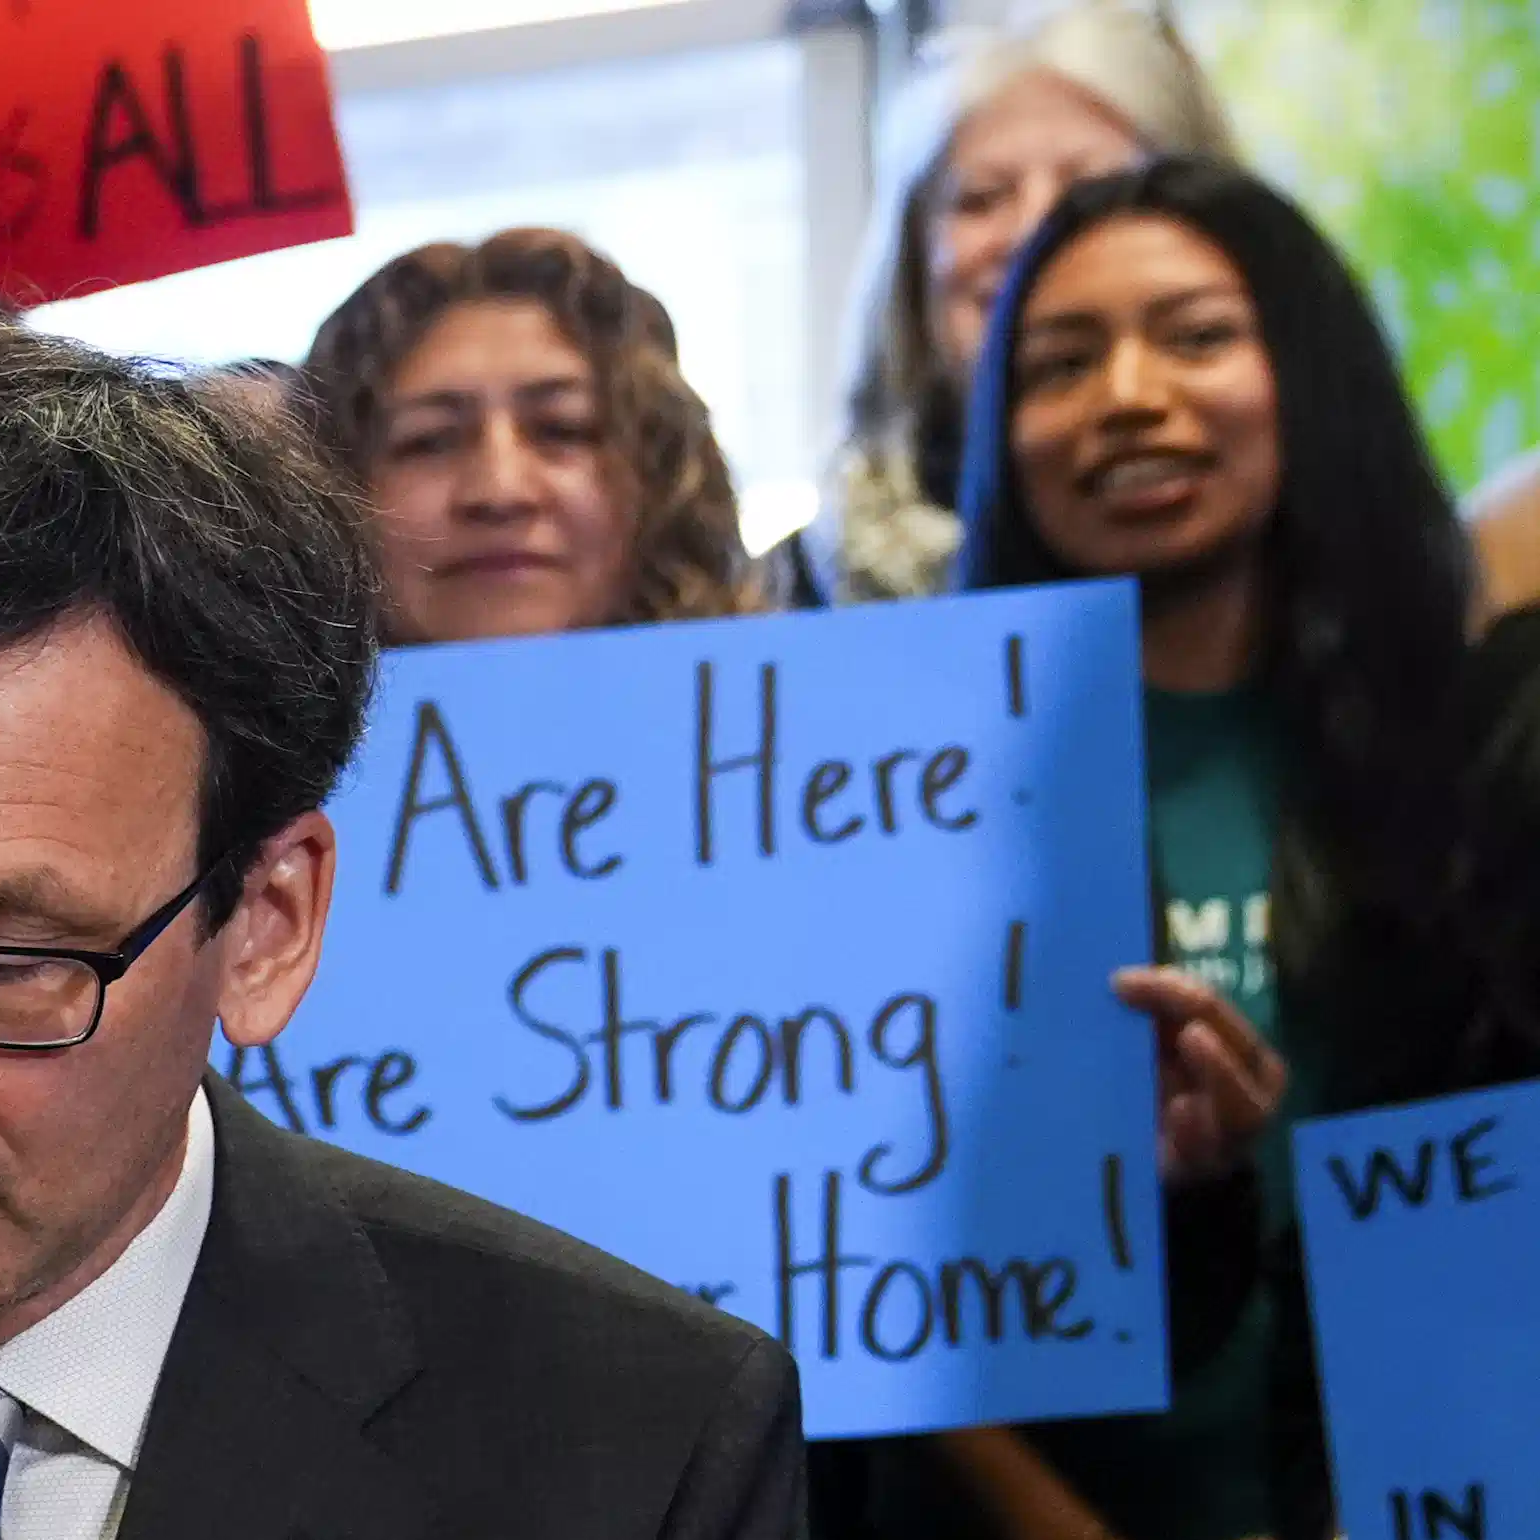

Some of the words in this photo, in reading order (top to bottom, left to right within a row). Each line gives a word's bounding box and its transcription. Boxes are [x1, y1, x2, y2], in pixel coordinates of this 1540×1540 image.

[75, 32, 352, 240] ALL
[385, 700, 625, 898] Are
[695, 630, 1030, 866] Here!
[492, 920, 1028, 1195] Strong!
[775, 1155, 1135, 1362] Home!
[1325, 1115, 1518, 1220] WE
